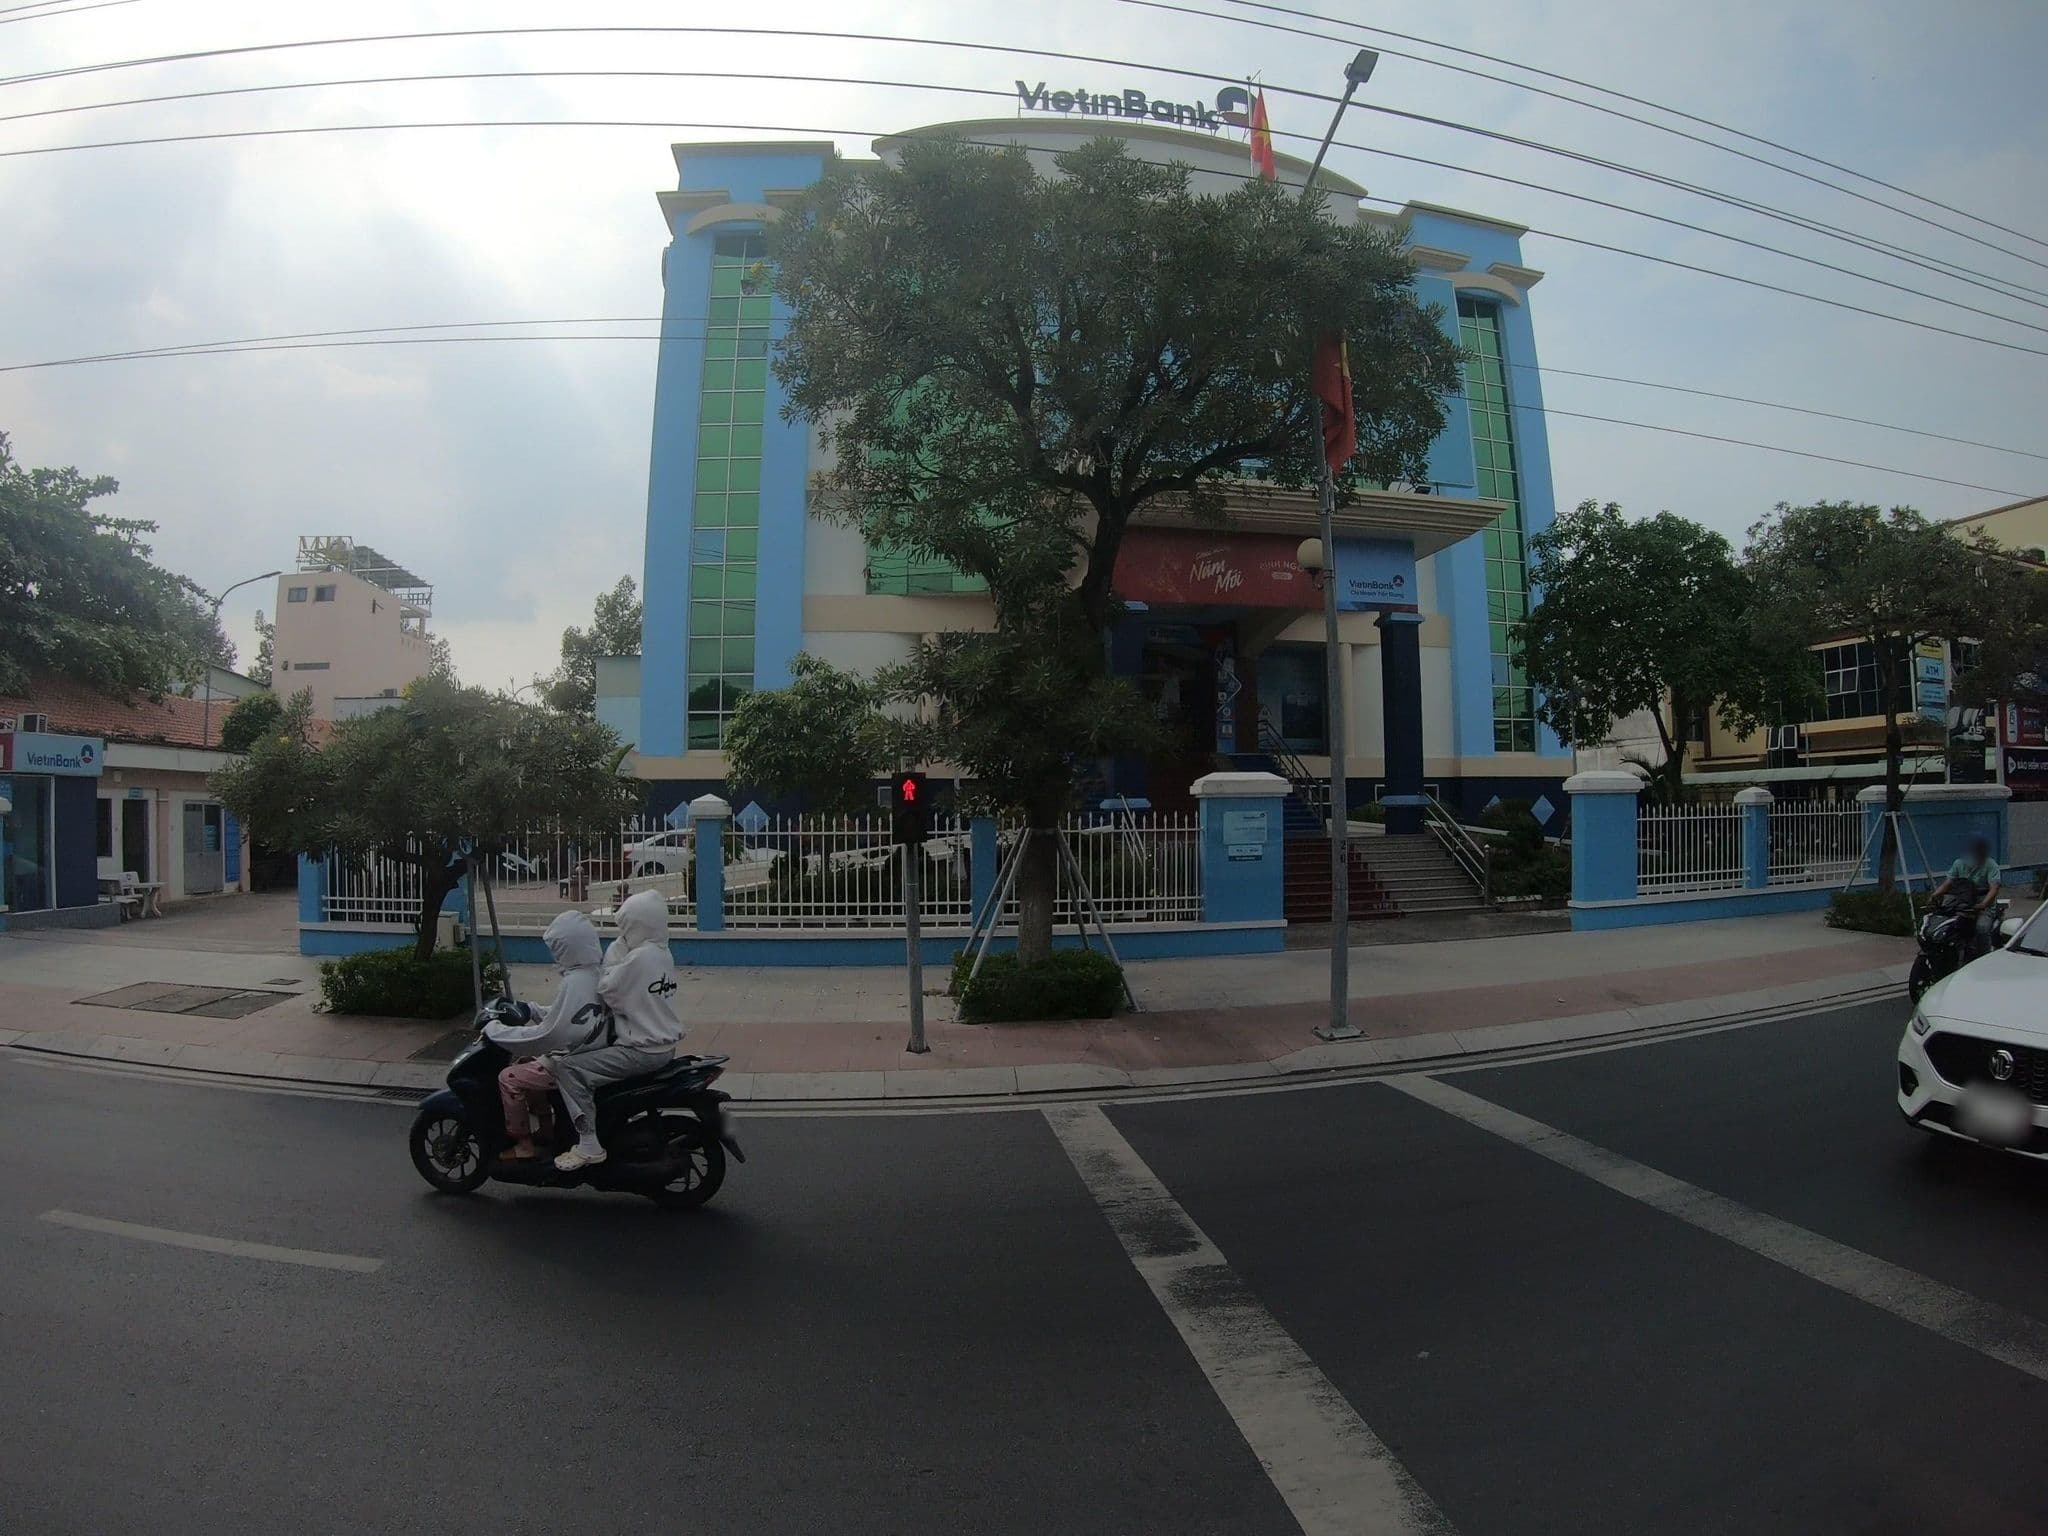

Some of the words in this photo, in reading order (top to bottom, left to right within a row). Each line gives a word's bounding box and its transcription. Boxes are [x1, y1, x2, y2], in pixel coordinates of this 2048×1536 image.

[1015, 80, 1220, 131] VietinBank
[1349, 579, 1395, 590] VietinBank
[27, 752, 81, 768] VietinBank
